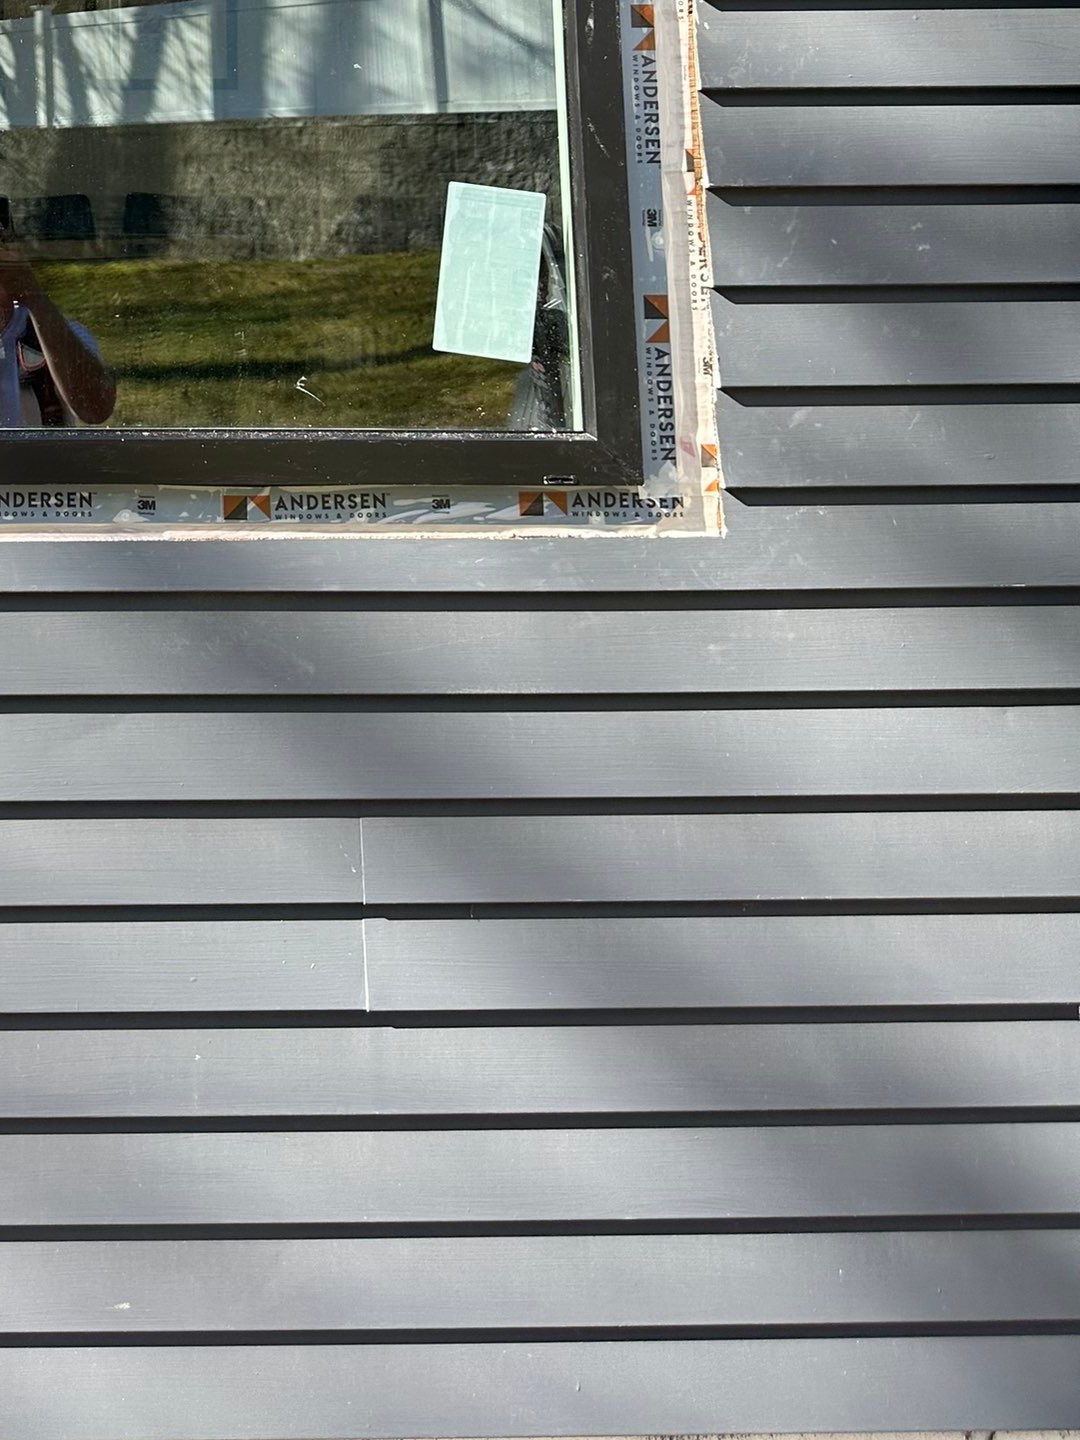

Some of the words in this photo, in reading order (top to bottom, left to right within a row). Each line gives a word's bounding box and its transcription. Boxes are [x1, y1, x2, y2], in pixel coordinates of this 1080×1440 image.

[641, 55, 661, 164] ANDERSEN
[647, 209, 657, 227] 3M
[654, 347, 677, 461] ANDERSEN
[137, 500, 156, 511] 3M
[275, 494, 387, 510] ANDERSEN
[431, 499, 450, 510] 3M
